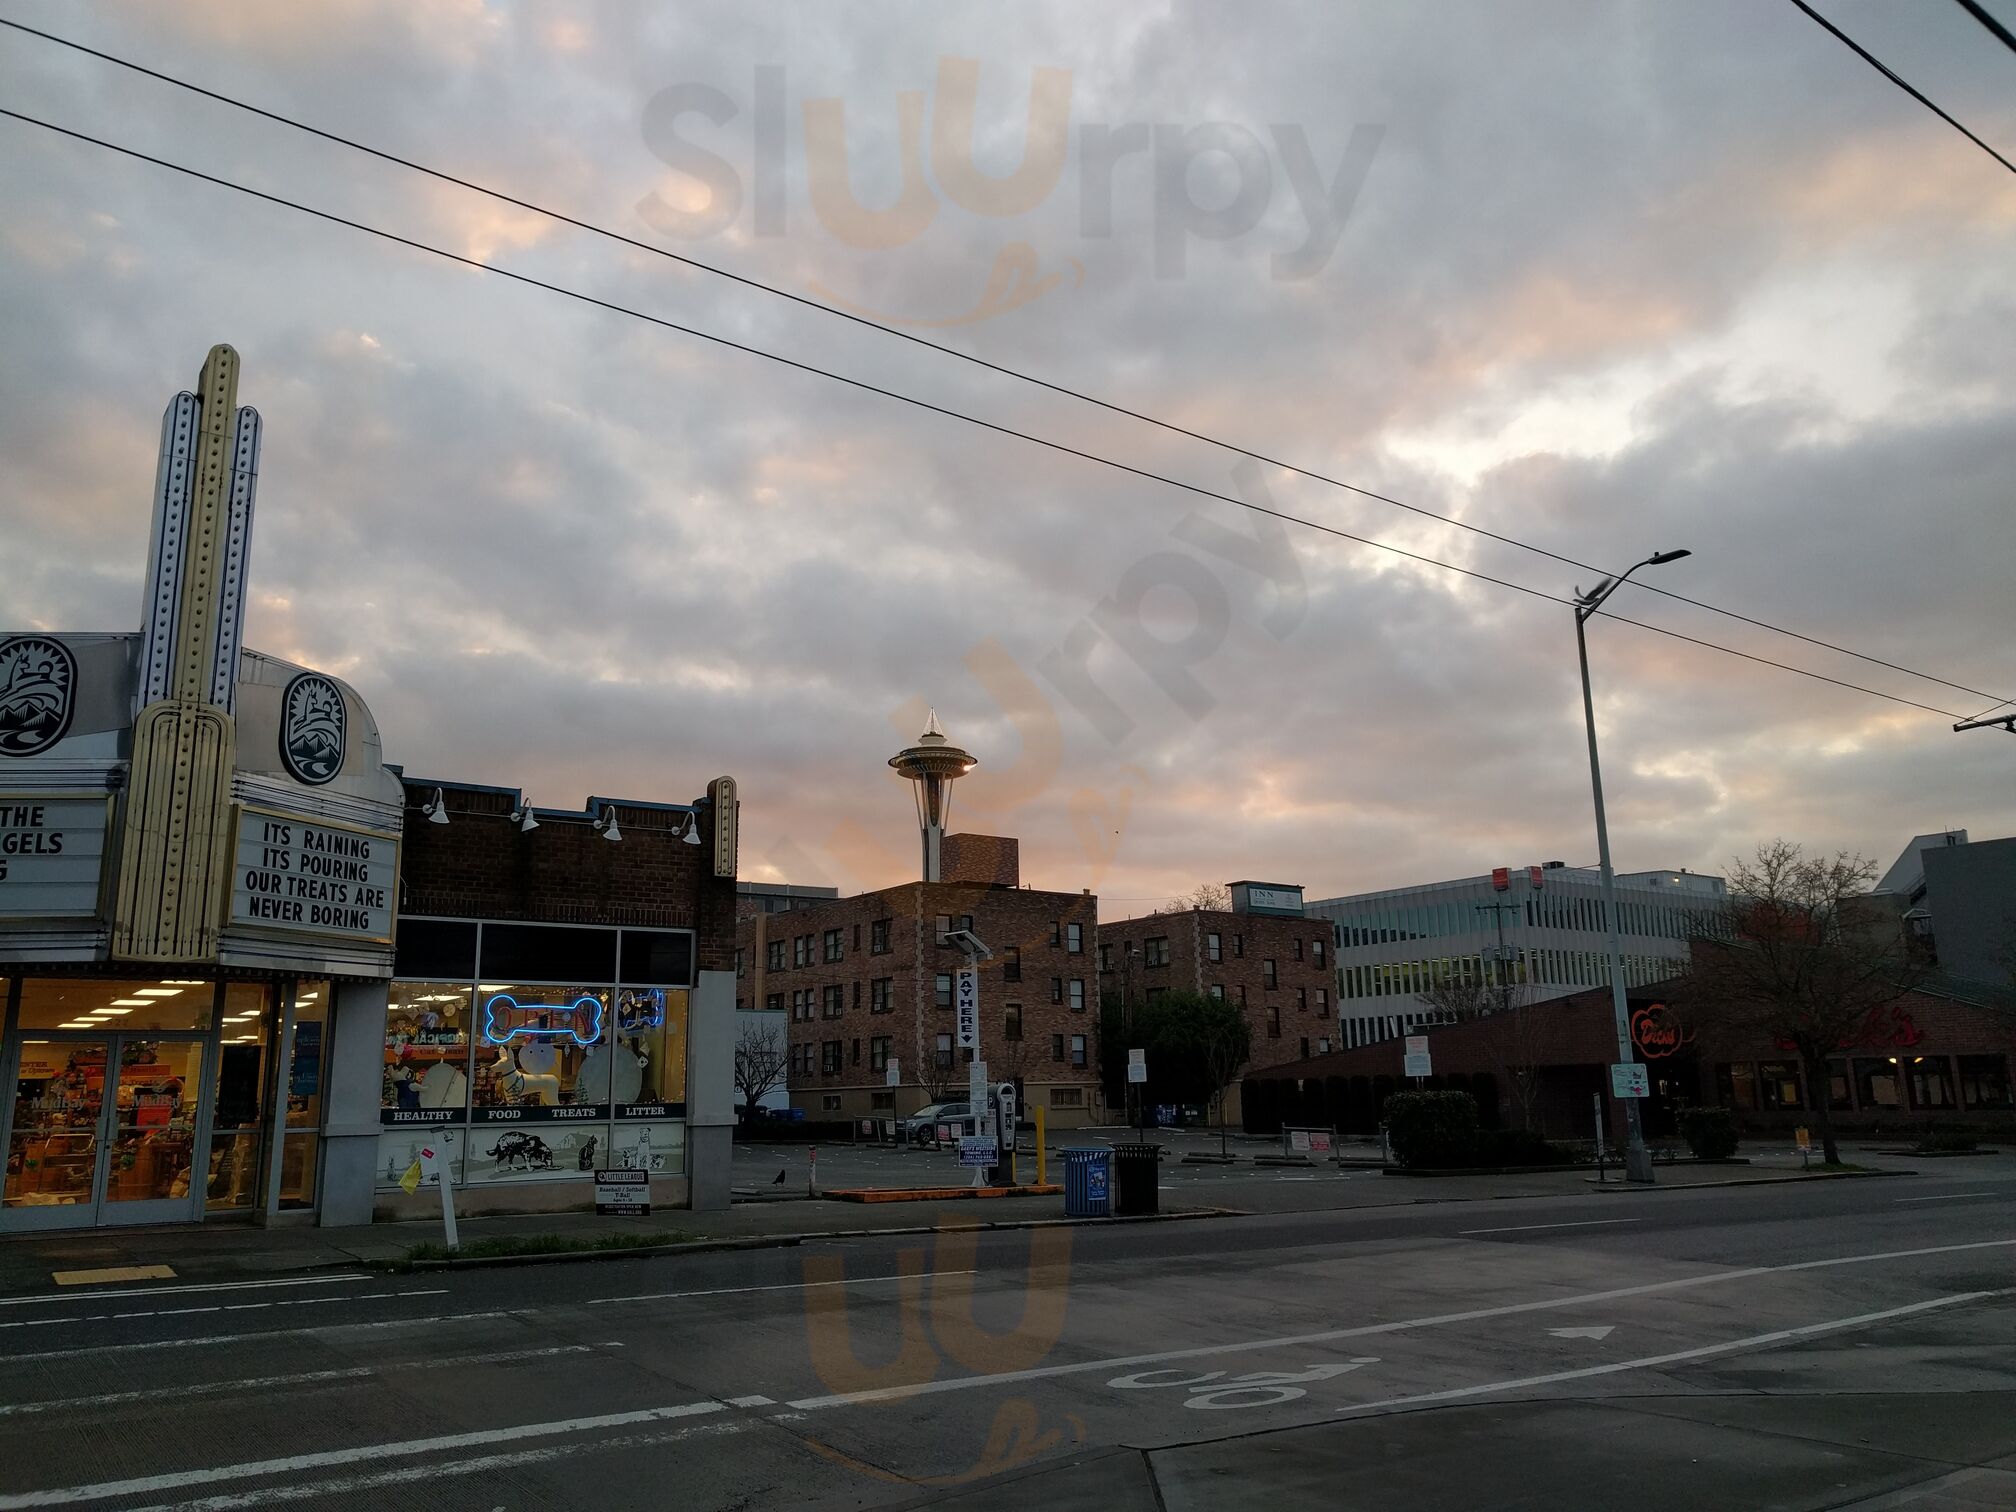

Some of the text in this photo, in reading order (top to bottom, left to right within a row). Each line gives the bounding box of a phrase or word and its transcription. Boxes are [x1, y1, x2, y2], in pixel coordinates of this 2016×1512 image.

[0, 806, 44, 827] THE
[2, 832, 63, 854] GELS
[263, 822, 370, 859] ITS RAINING
[262, 847, 368, 883] ITS POURING
[245, 870, 384, 909] OUR TREATS ARE
[249, 896, 370, 930] NEVER BORING
[959, 971, 973, 1033] PAY HERE
[494, 1006, 596, 1035] OPEN
[393, 1106, 665, 1121] HEALTHY FOOD TREATS LITTER
